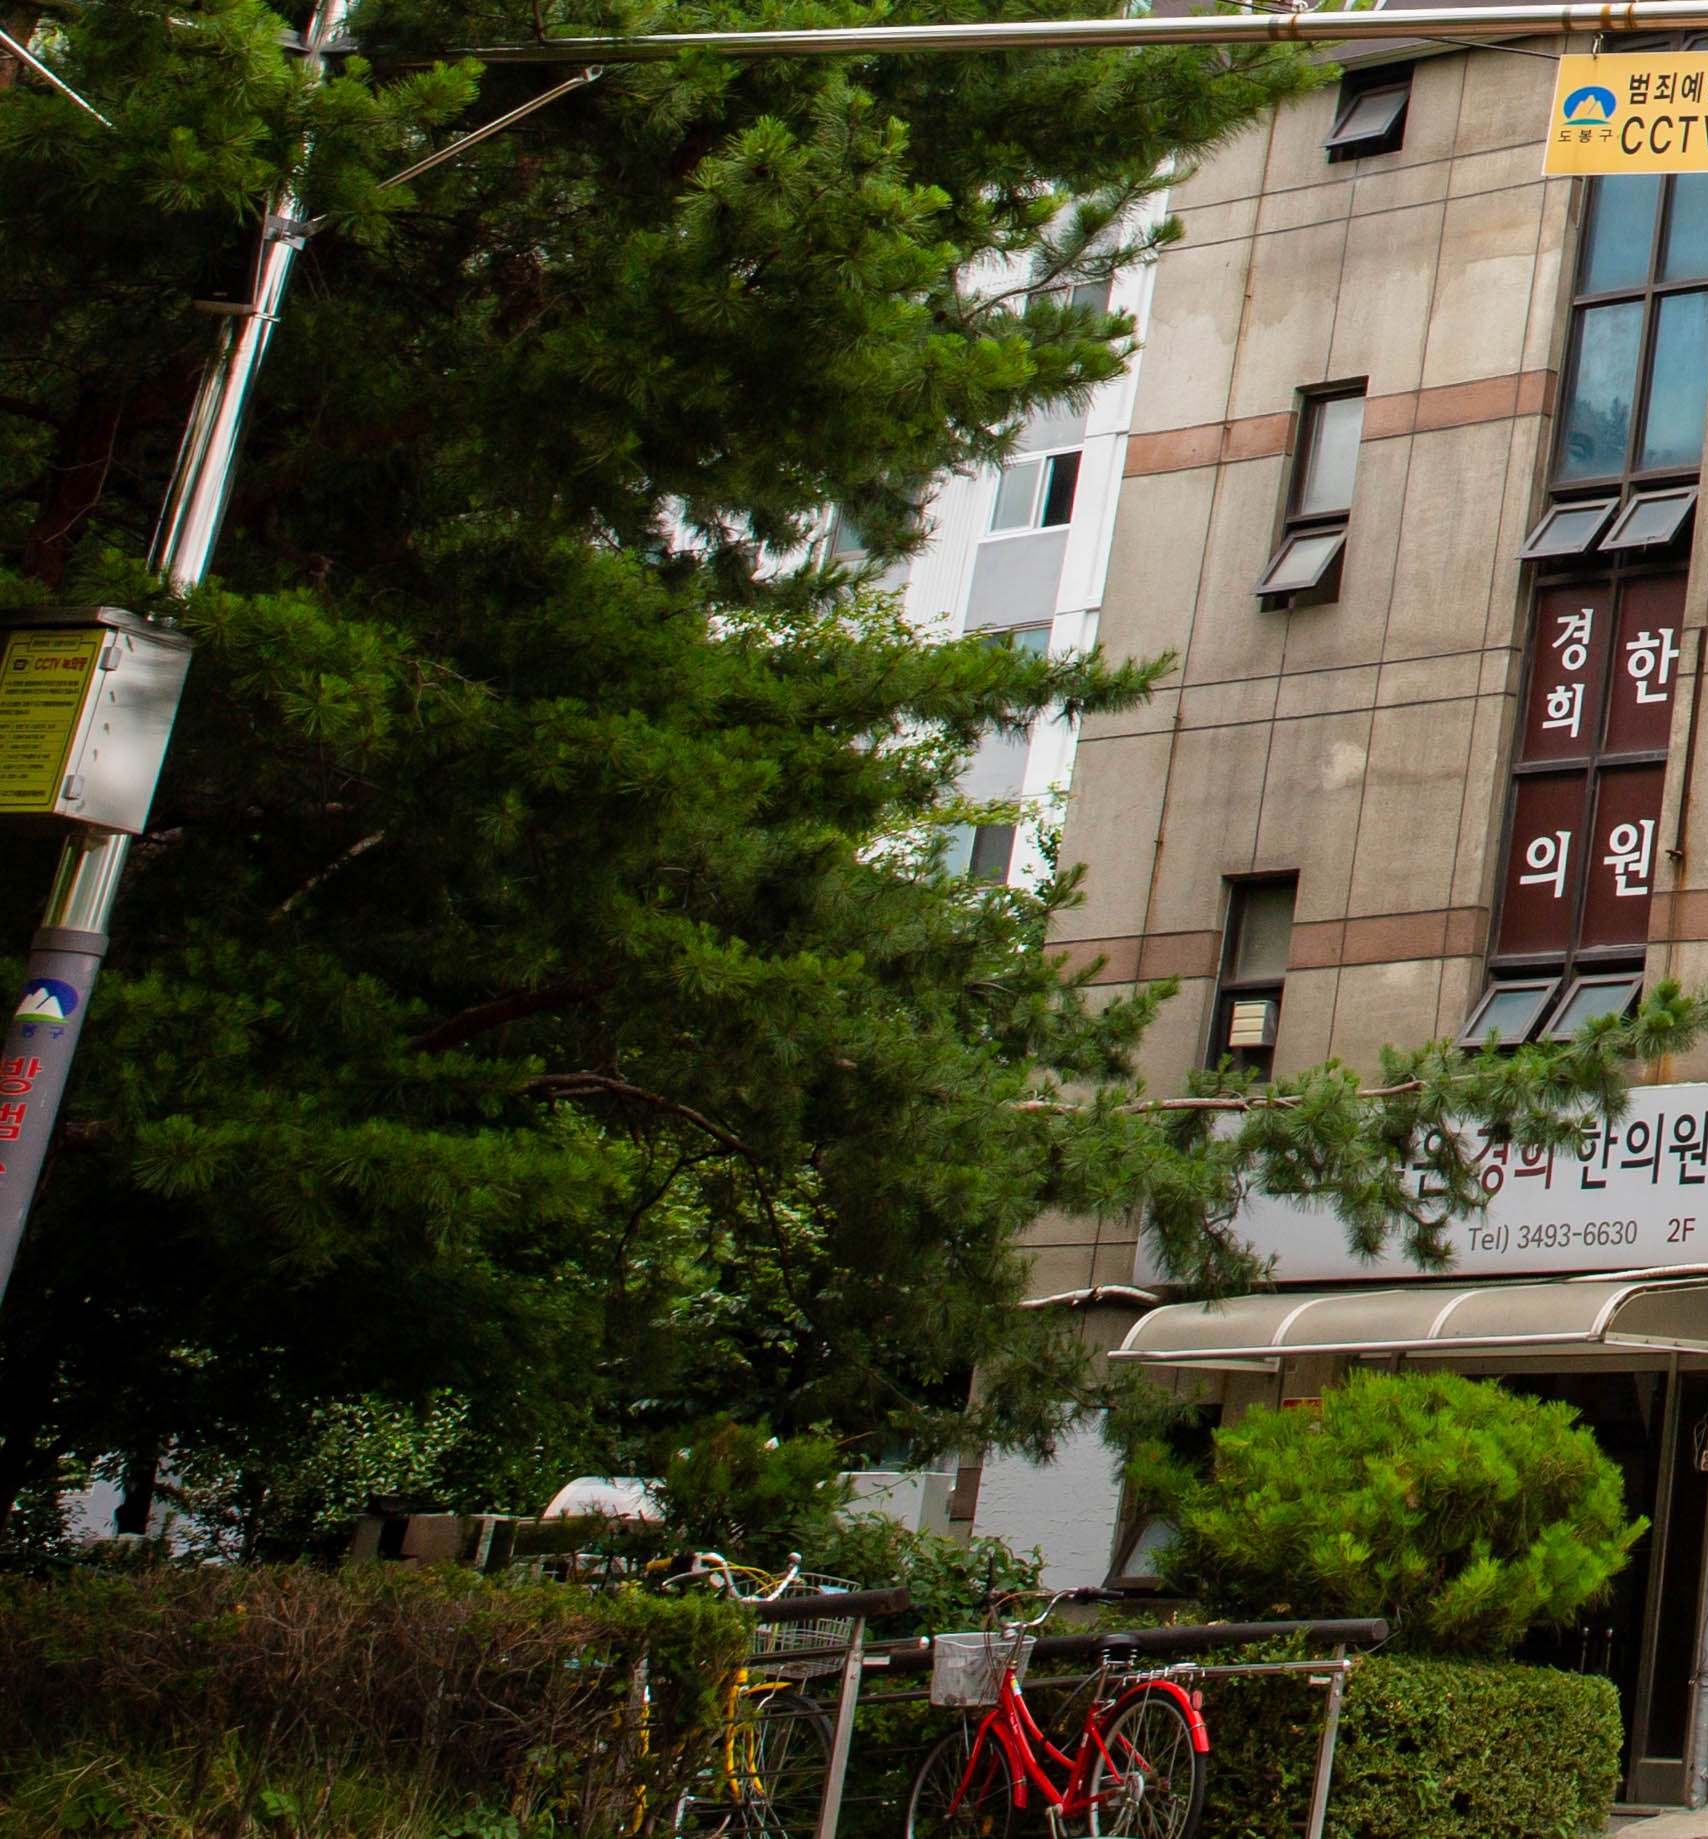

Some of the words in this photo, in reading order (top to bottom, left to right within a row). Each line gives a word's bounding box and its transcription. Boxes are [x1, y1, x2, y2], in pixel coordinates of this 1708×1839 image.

[1557, 128, 1613, 143] 도봉구
[1468, 1226, 1509, 1253] Tel)
[1517, 1219, 1638, 1251] 3493-6630
[1667, 1217, 1696, 1244] 2F
